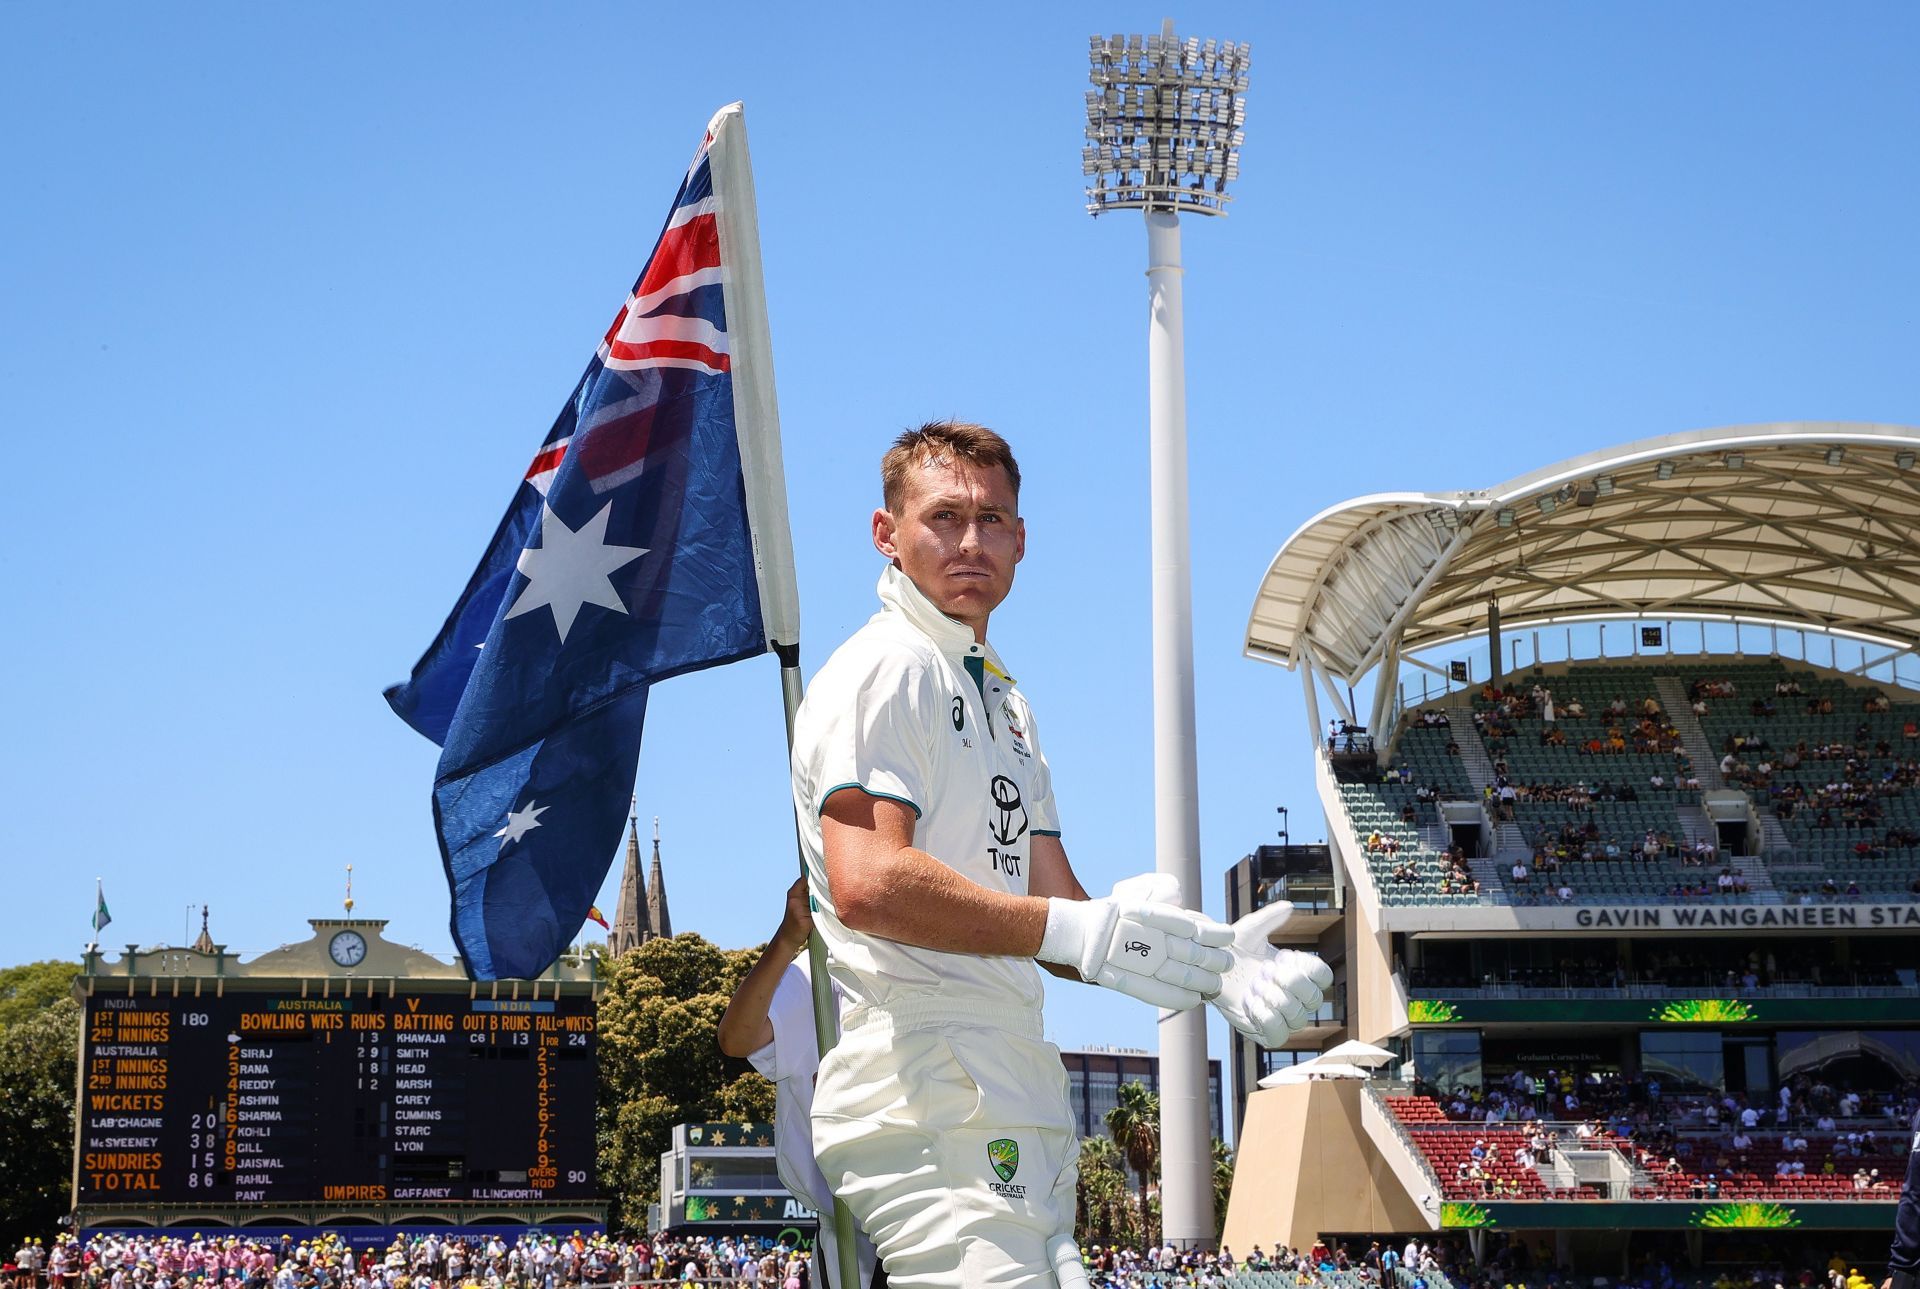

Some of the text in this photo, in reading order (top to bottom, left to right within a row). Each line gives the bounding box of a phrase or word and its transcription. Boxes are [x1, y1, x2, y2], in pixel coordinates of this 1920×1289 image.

[1576, 909, 1660, 927] GAVIN
[1673, 907, 1856, 926] WANGANEEN
[104, 1000, 137, 1009] INDIA
[278, 1000, 342, 1010] AUSTRALIA
[407, 999, 420, 1012] V
[494, 1002, 532, 1010] INDIA
[119, 1012, 170, 1026] INNINGS
[182, 1012, 208, 1026] 180
[241, 1014, 385, 1030] BOWLING WKTS RUNS
[394, 1014, 454, 1030] BATTING
[463, 1015, 531, 1031] OUT B RUNS
[536, 1016, 594, 1032] FALL OF WKTS
[118, 1028, 169, 1042] INNINGS
[396, 1033, 446, 1044] KHAWAJA
[470, 1033, 486, 1043] C6
[546, 1038, 558, 1046] FOR
[568, 1034, 586, 1046] 24
[95, 1046, 158, 1056] AUSTRALIA
[228, 1046, 273, 1060] 2 SIRAJ
[396, 1048, 429, 1058] SMITH
[537, 1048, 546, 1062] 2
[116, 1060, 168, 1073] INNINGS
[228, 1062, 270, 1077] 3 RANA
[396, 1064, 426, 1074] HEAD
[538, 1062, 548, 1077] 3
[116, 1075, 167, 1090] INNINGS
[227, 1078, 276, 1092] 4 REDDY
[396, 1080, 432, 1090] MARSH
[538, 1078, 548, 1092] 4
[92, 1095, 164, 1110] WICKETS
[228, 1094, 280, 1108] 5 ASHWIN
[396, 1095, 431, 1105] CAREY
[538, 1092, 548, 1108] 5
[226, 1109, 282, 1123] 6 SHARMA
[395, 1110, 442, 1120] CUMMINS
[538, 1108, 548, 1122] 6
[225, 1124, 270, 1139] 7 KOHLI
[395, 1126, 430, 1136] STARC
[538, 1124, 548, 1138] 7
[225, 1140, 262, 1155] 8 GILL
[395, 1142, 424, 1152] LYON
[538, 1138, 548, 1154] 8
[85, 1154, 162, 1170] SUNDRIES
[224, 1156, 284, 1170] 9 JAISWAL
[538, 1154, 548, 1168] 9
[91, 1173, 160, 1190] TOTAL
[236, 1174, 272, 1184] RAHUL
[528, 1166, 586, 1184] OVERS 90
[235, 1190, 266, 1200] PANT
[324, 1186, 542, 1200] UMPIRES GAFFANEY ILLINGWORTH
[989, 1182, 1026, 1194] CRICKET
